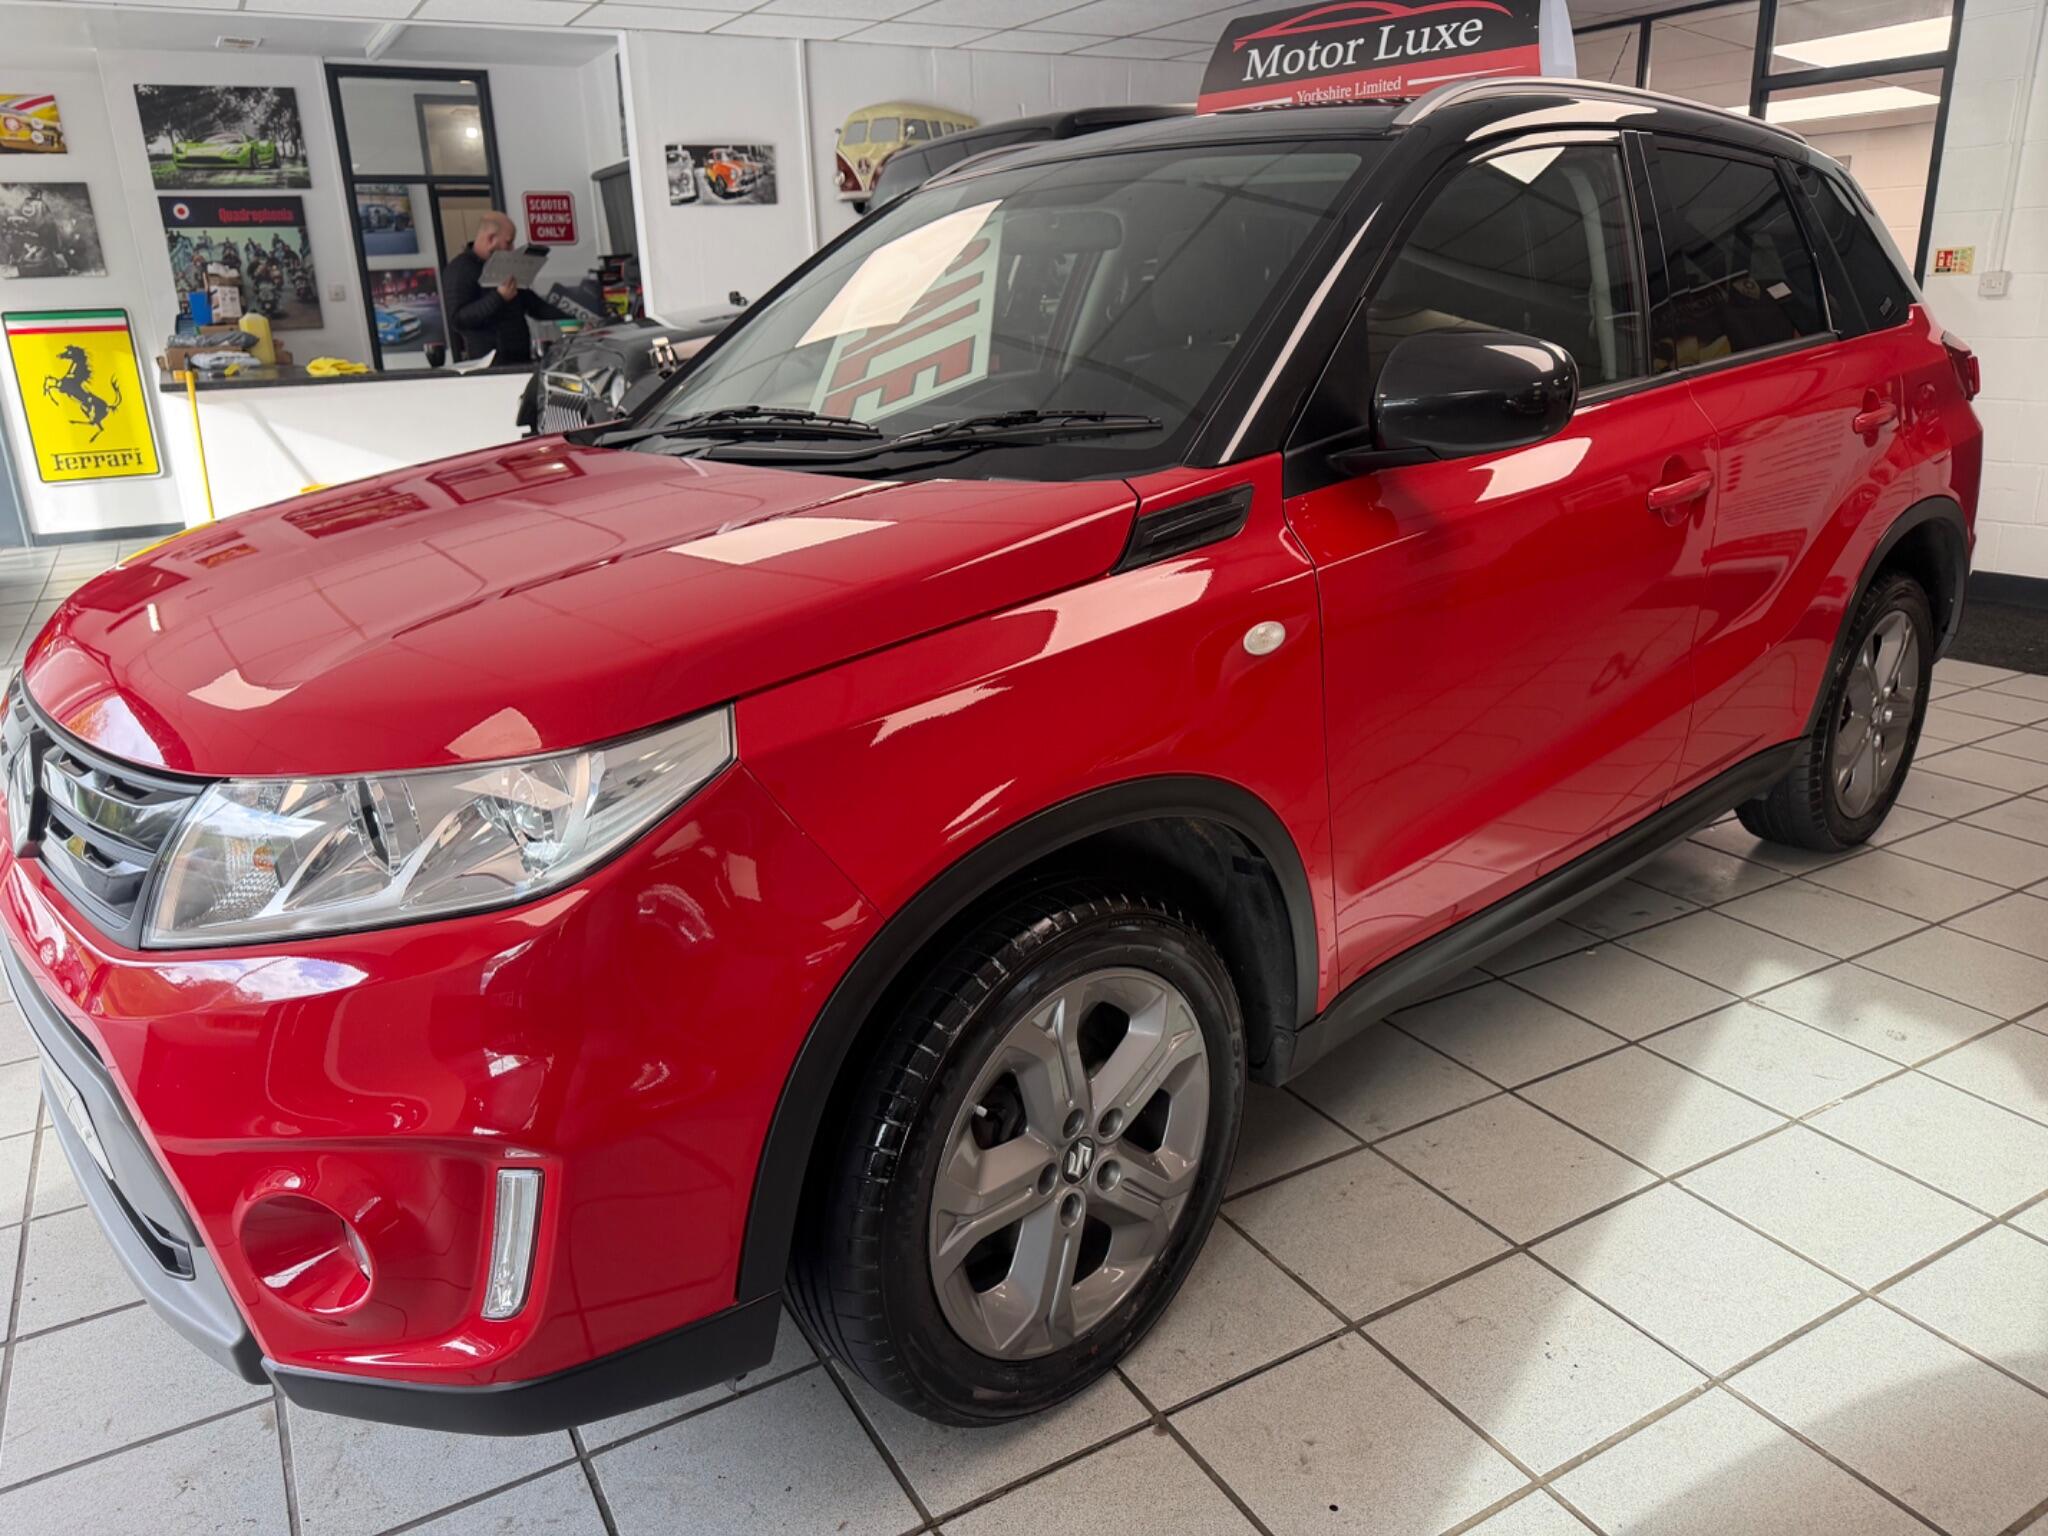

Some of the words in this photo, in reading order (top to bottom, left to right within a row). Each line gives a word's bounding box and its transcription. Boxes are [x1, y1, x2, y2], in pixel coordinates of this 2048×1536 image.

[1242, 37, 1366, 82] Motor
[1373, 17, 1484, 62] Luxe
[1296, 83, 1352, 104] Yorkshire
[1354, 76, 1402, 97] Limited
[528, 199, 569, 211] SCOOTER
[529, 212, 572, 225] PARKING
[537, 226, 567, 238] ONLY
[51, 447, 144, 472] Ferrari
